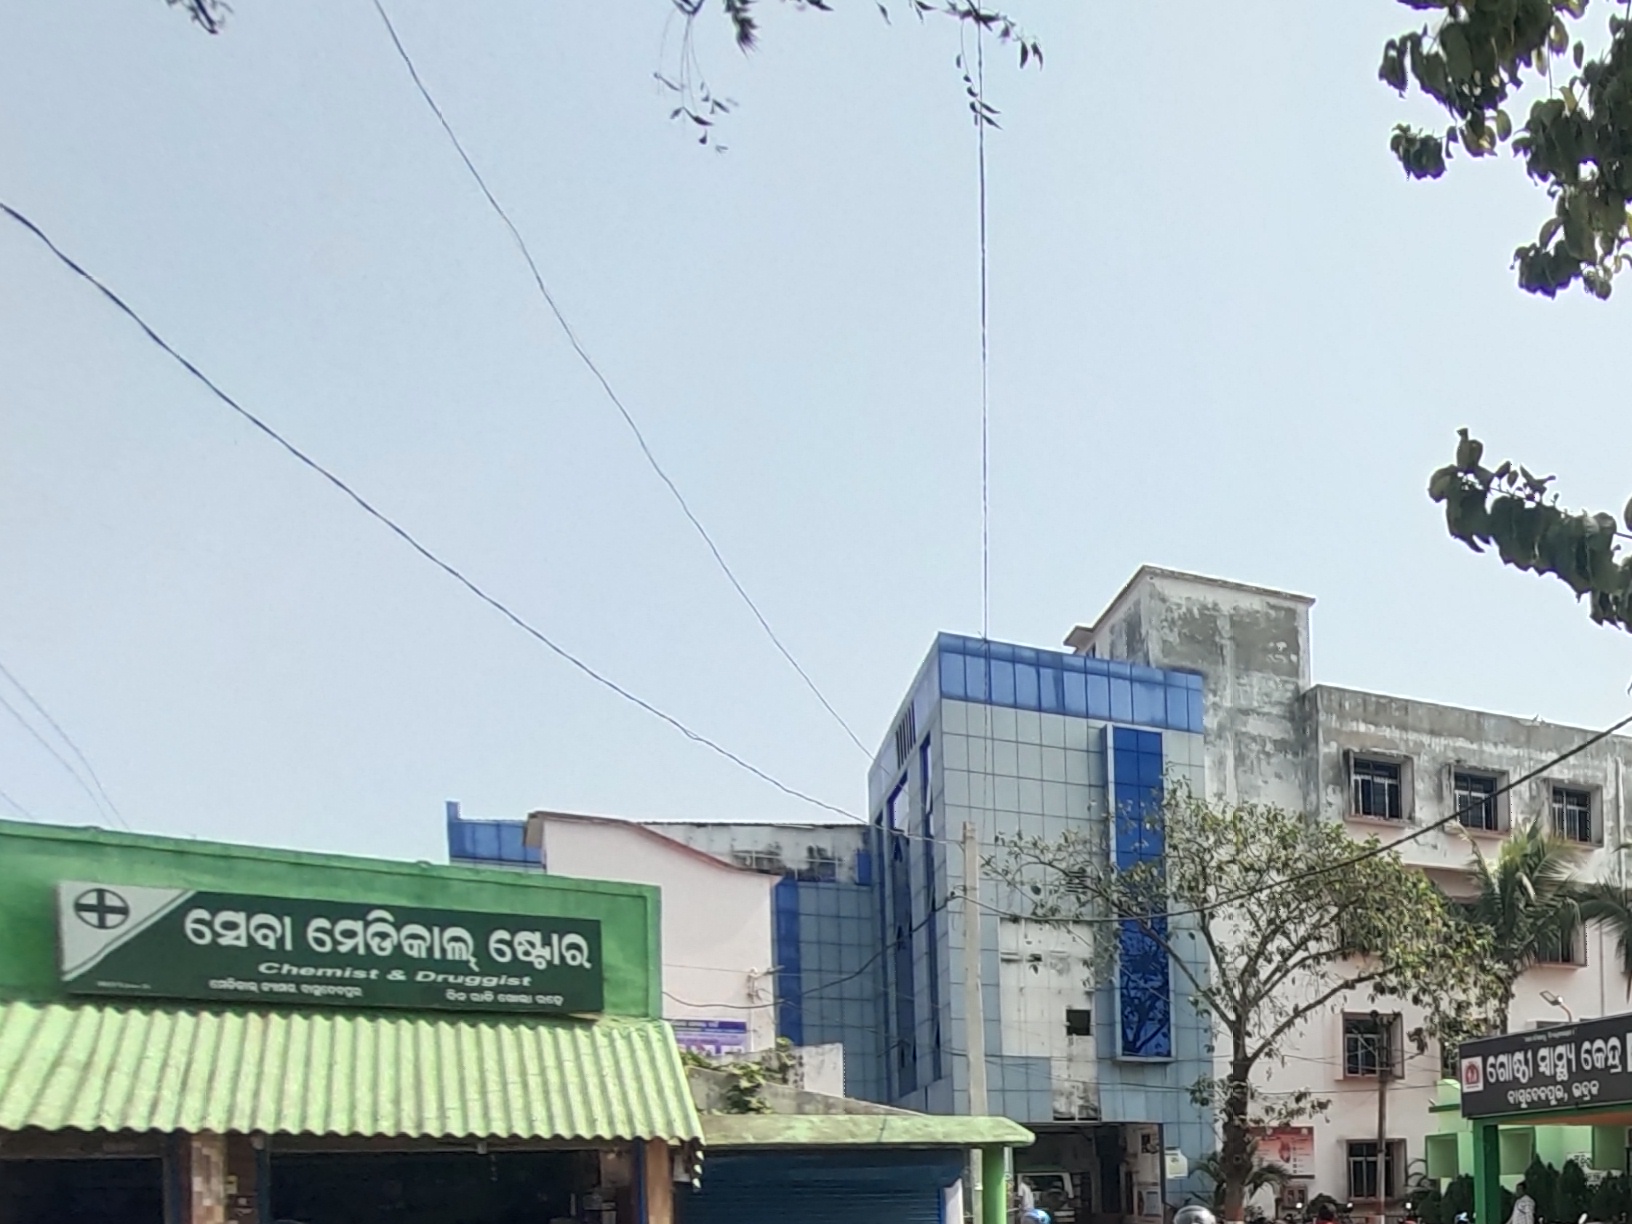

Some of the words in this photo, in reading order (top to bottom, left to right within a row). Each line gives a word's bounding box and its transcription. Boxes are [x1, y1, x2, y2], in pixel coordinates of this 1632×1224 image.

[184, 908, 293, 951] ସେବା
[306, 908, 480, 972] ମେଡିକାଲ୍
[488, 929, 592, 970] ଷ୍ଟୋର
[258, 961, 380, 980] Chemist
[386, 969, 407, 981] &
[415, 970, 533, 987] Druggist
[1486, 1048, 1533, 1084] ଗୋଷ୍ଠୀ
